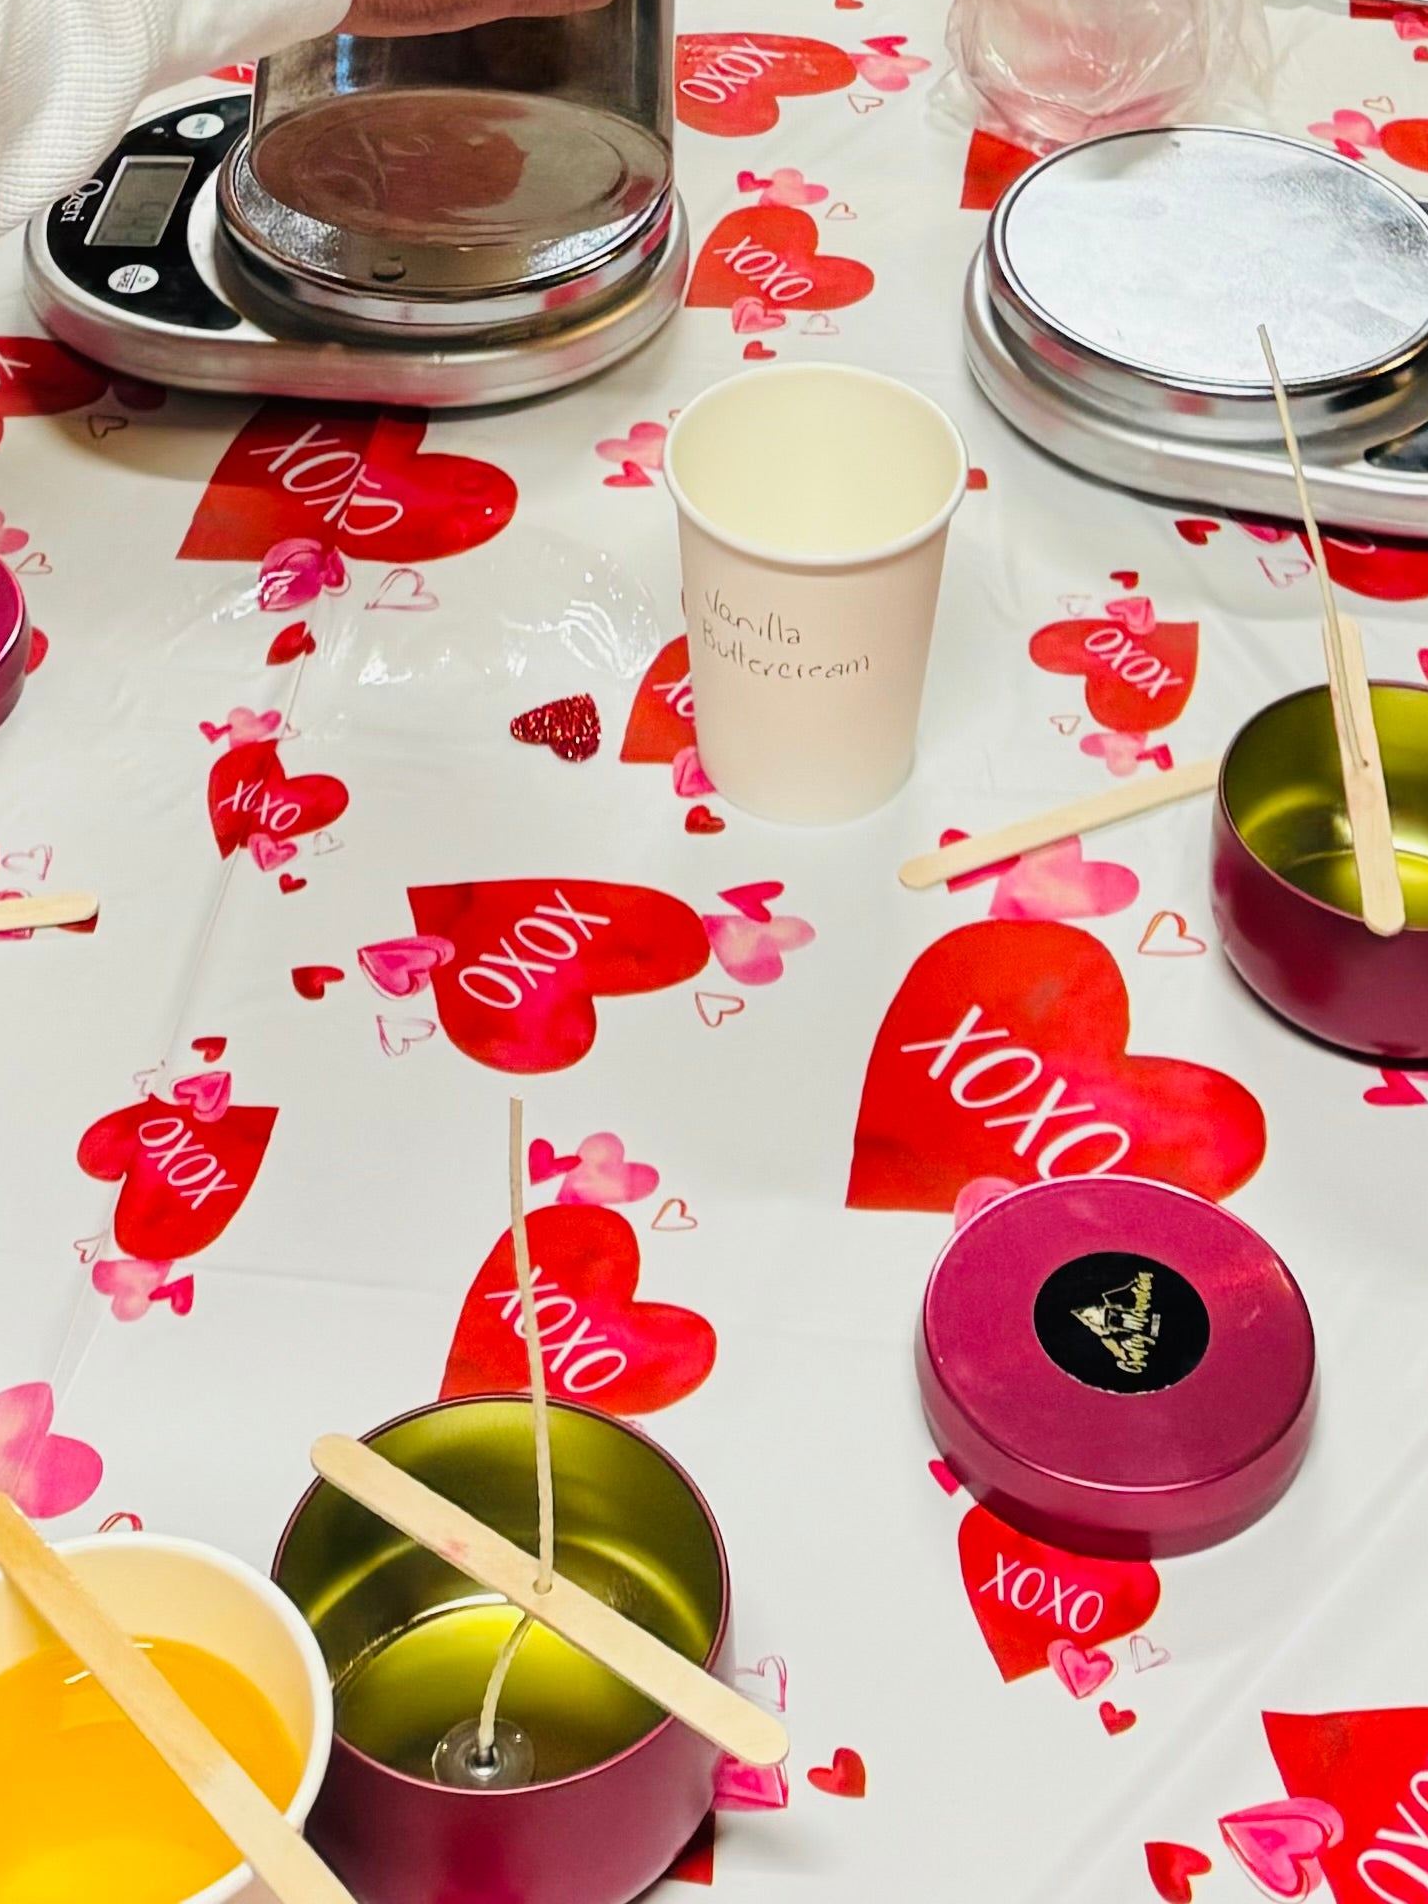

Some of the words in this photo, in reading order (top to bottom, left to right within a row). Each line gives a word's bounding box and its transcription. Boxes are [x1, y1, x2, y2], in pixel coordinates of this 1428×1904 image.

[713, 235, 814, 301] XOXO
[703, 623, 871, 680] Buttercream
[704, 589, 801, 646] Vanilla
[900, 1004, 1130, 1179] XOXO
[485, 1267, 626, 1394] XOXO
[982, 1554, 1104, 1633] XOXO
